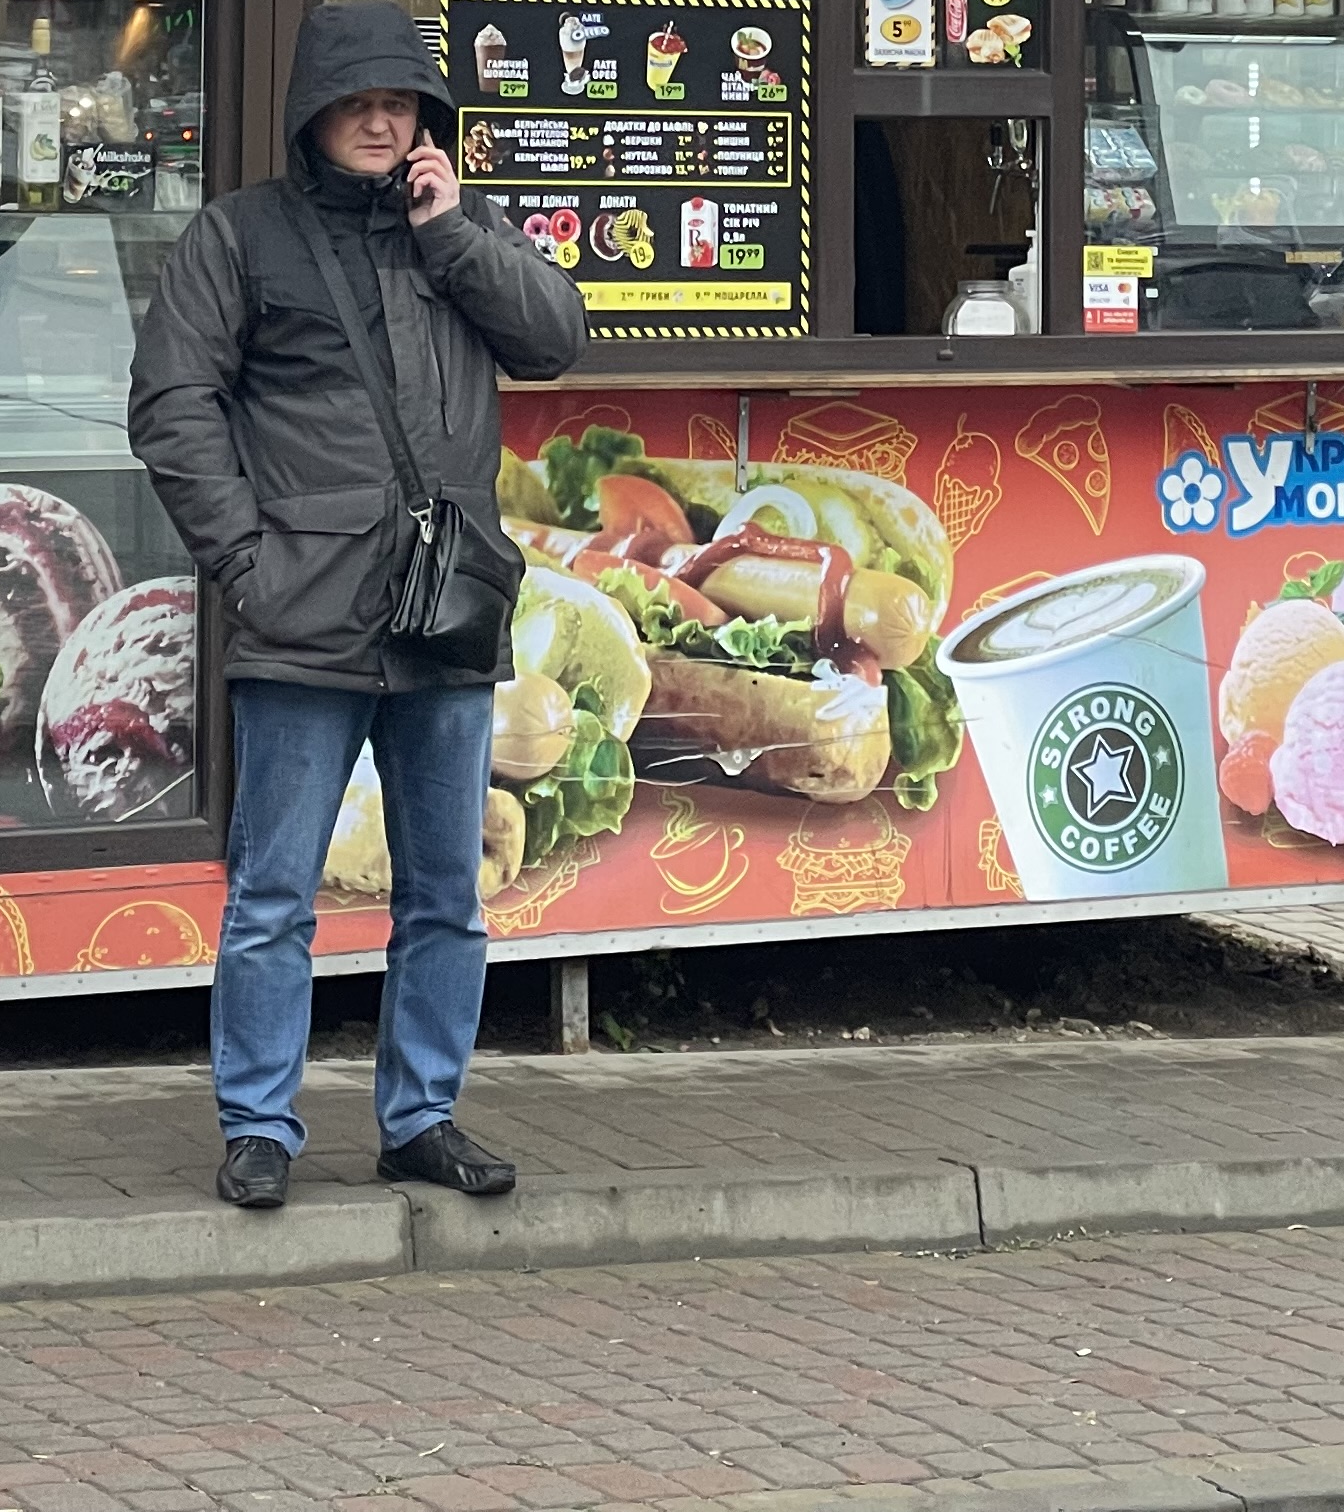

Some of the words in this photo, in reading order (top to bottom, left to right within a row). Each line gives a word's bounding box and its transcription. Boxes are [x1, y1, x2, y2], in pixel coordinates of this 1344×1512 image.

[487, 58, 529, 69] ГАРЯЧИЙ
[594, 60, 617, 69] ЛАТЕ
[484, 69, 529, 80] ШОКОЛАД
[592, 70, 617, 80] ОРЕО
[721, 71, 742, 82] ЧАЙ
[604, 121, 646, 132] ДОДАТКИ
[647, 122, 660, 133] ДО
[97, 151, 151, 162] Milkshake
[519, 195, 540, 208] МІНІ
[542, 195, 579, 208] ДОНАТИ
[599, 195, 637, 209] ДОНАТИ
[723, 202, 777, 214] ТОМАТНИЙ
[723, 218, 740, 227] СІК
[742, 218, 760, 227] РІЧ
[1089, 283, 1109, 292] VISA
[640, 292, 669, 301] ГРИБИ
[715, 292, 767, 300] МОЦАРЕЛЛА
[1040, 694, 1156, 772] STRONG
[1059, 791, 1174, 862] COFFEE
